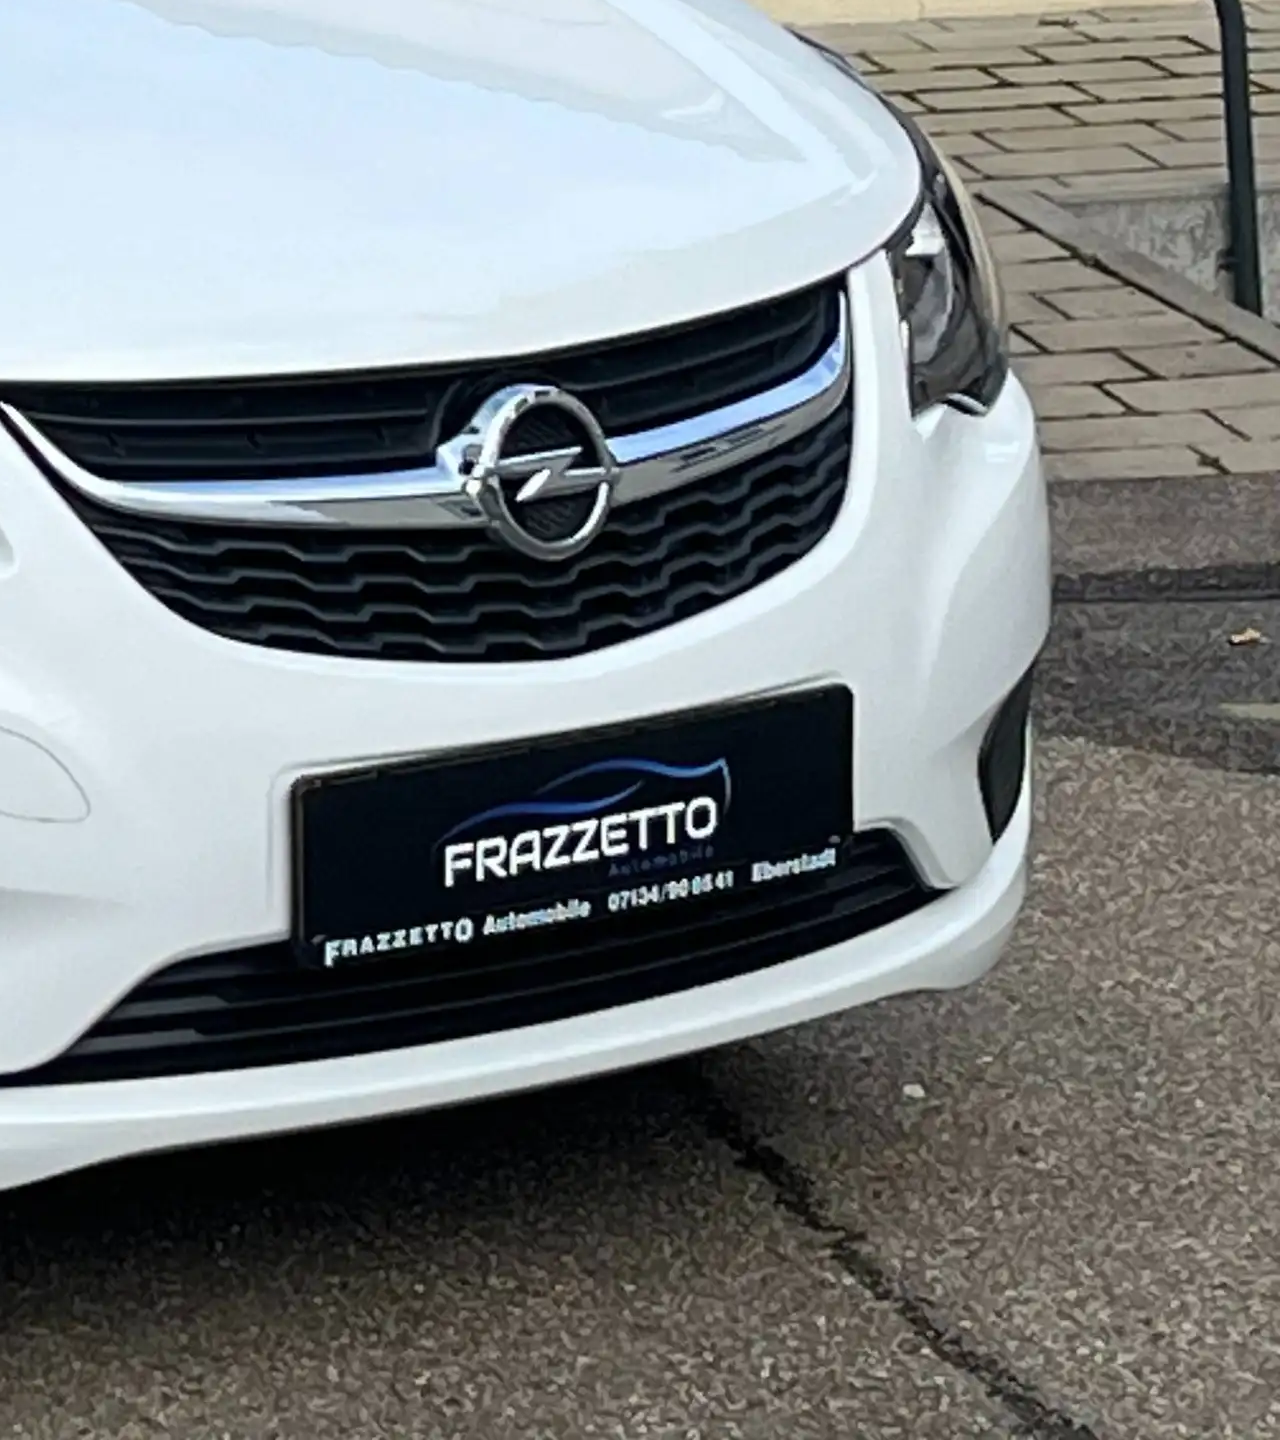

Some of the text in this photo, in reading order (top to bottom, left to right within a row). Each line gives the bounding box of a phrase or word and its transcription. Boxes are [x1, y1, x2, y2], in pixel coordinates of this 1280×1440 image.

[443, 795, 719, 888] FRAZZETTO
[324, 916, 475, 968] FRAZZETTO
[482, 897, 592, 936] Automobile
